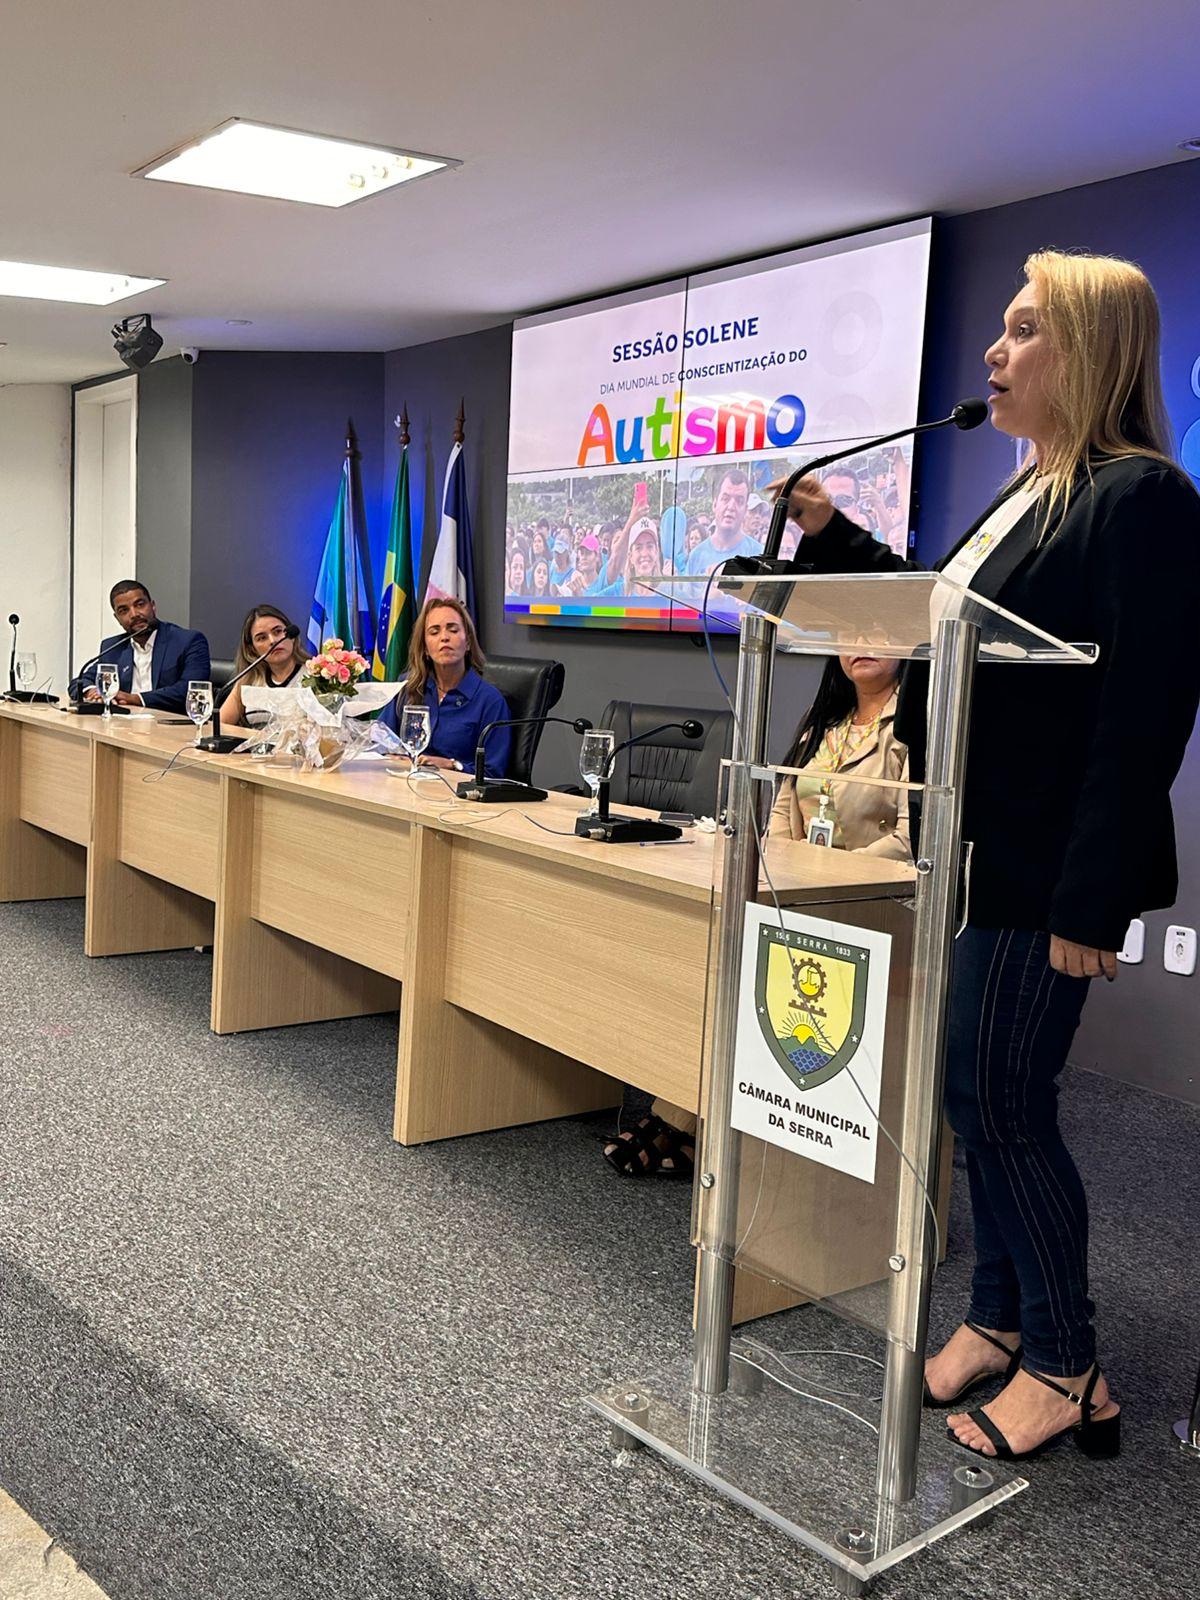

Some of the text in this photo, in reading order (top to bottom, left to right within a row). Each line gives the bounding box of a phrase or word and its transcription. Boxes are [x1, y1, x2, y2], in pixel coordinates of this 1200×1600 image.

[612, 317, 759, 363] SESSÃO SOLENE
[600, 349, 807, 395] DIA MUNDIAL DE CONSCIENTIZAÇÃO DO
[577, 391, 806, 467] Autismo
[797, 937, 828, 951] SERRA
[835, 946, 851, 957] 1833
[738, 1081, 871, 1140] CÂMARA MUNICIPAL
[768, 1113, 833, 1148] DA SERRA
